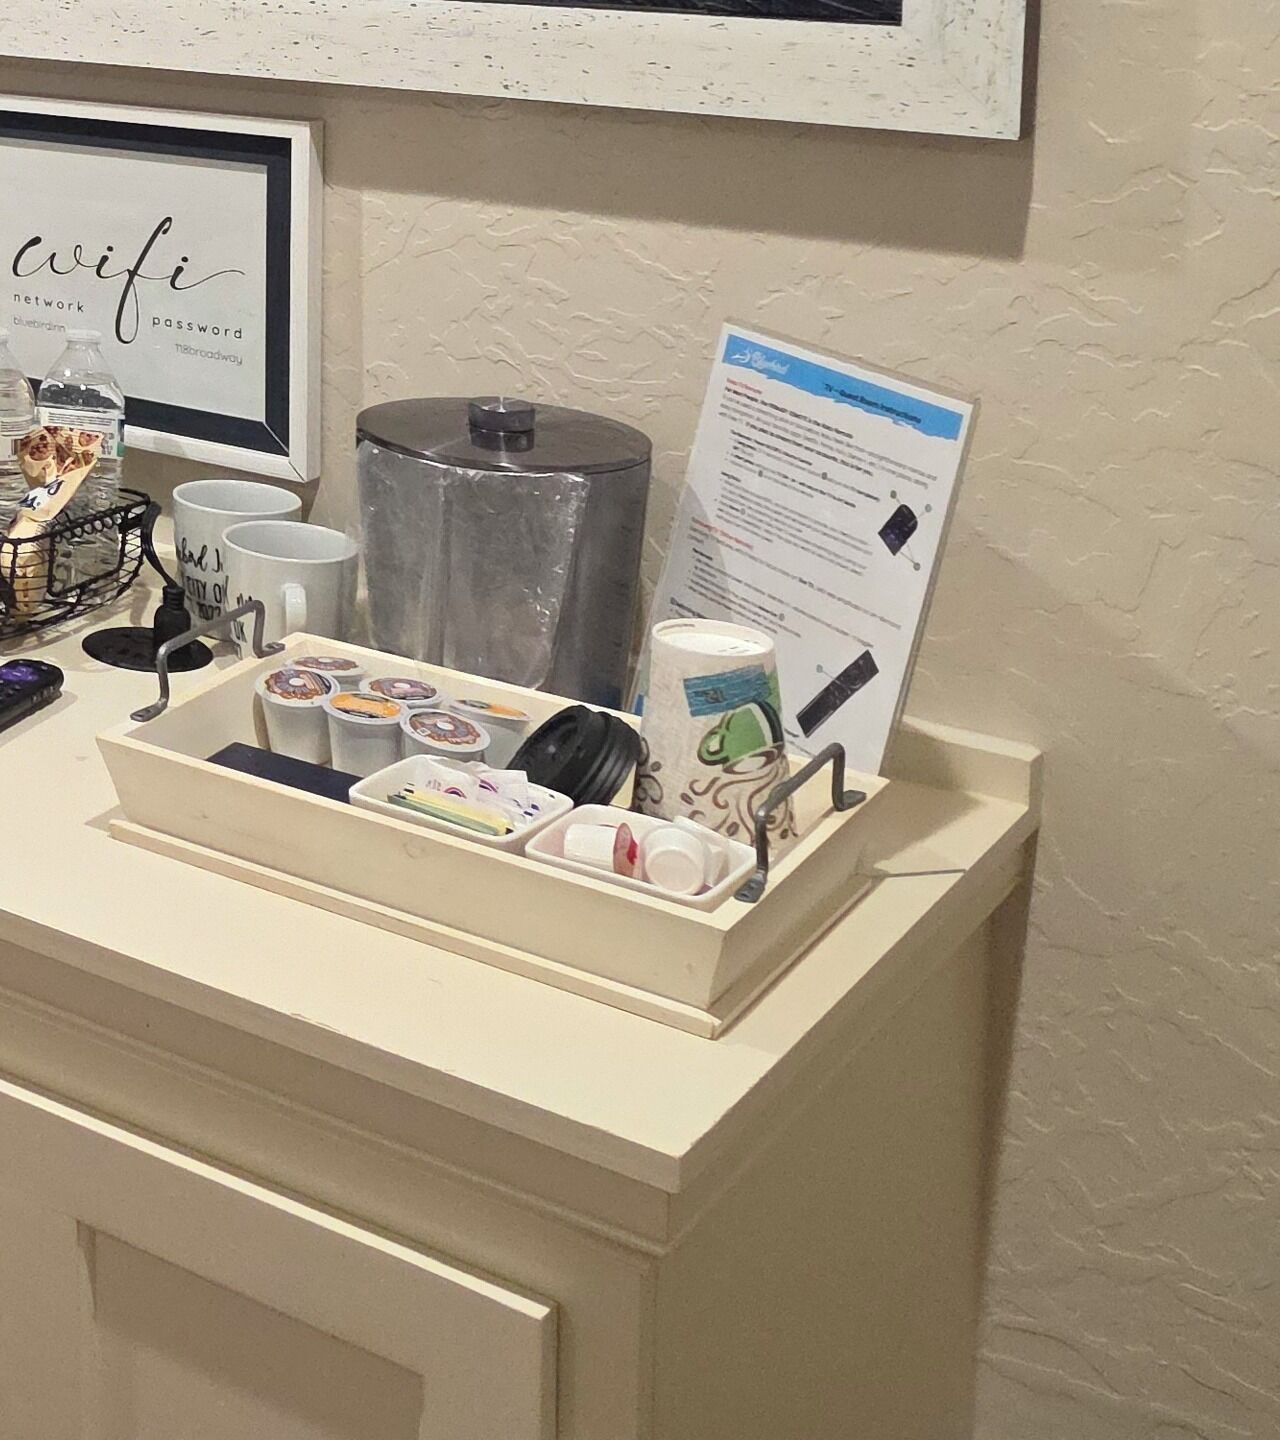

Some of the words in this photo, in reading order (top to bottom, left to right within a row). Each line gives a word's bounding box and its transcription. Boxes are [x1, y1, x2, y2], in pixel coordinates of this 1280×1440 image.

[11, 216, 246, 344] wifi
[13, 292, 85, 313] network
[151, 315, 243, 340] password
